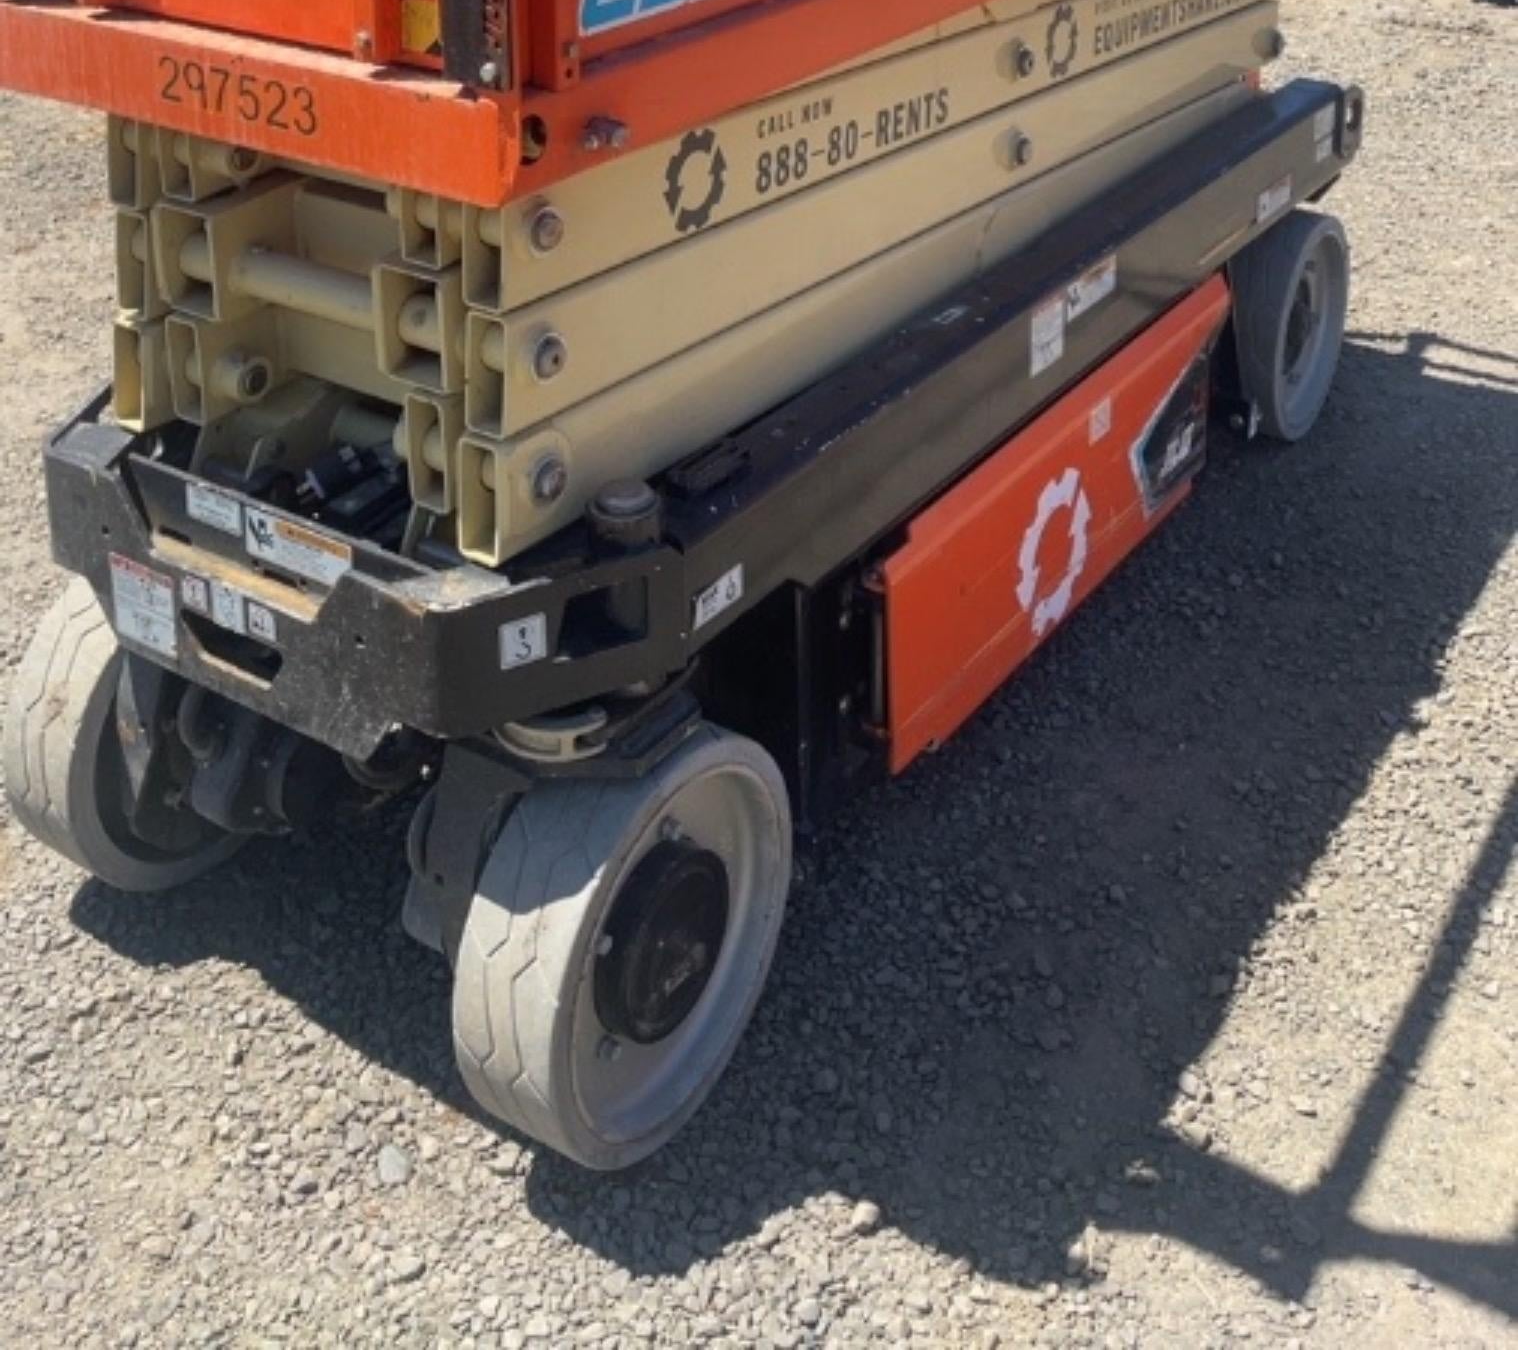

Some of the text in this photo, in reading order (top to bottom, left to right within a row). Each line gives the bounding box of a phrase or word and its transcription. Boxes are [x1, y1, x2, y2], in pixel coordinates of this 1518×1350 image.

[159, 55, 317, 136] 297523
[757, 98, 833, 139] CALL NOW
[756, 87, 949, 194] 888-80-RENTS
